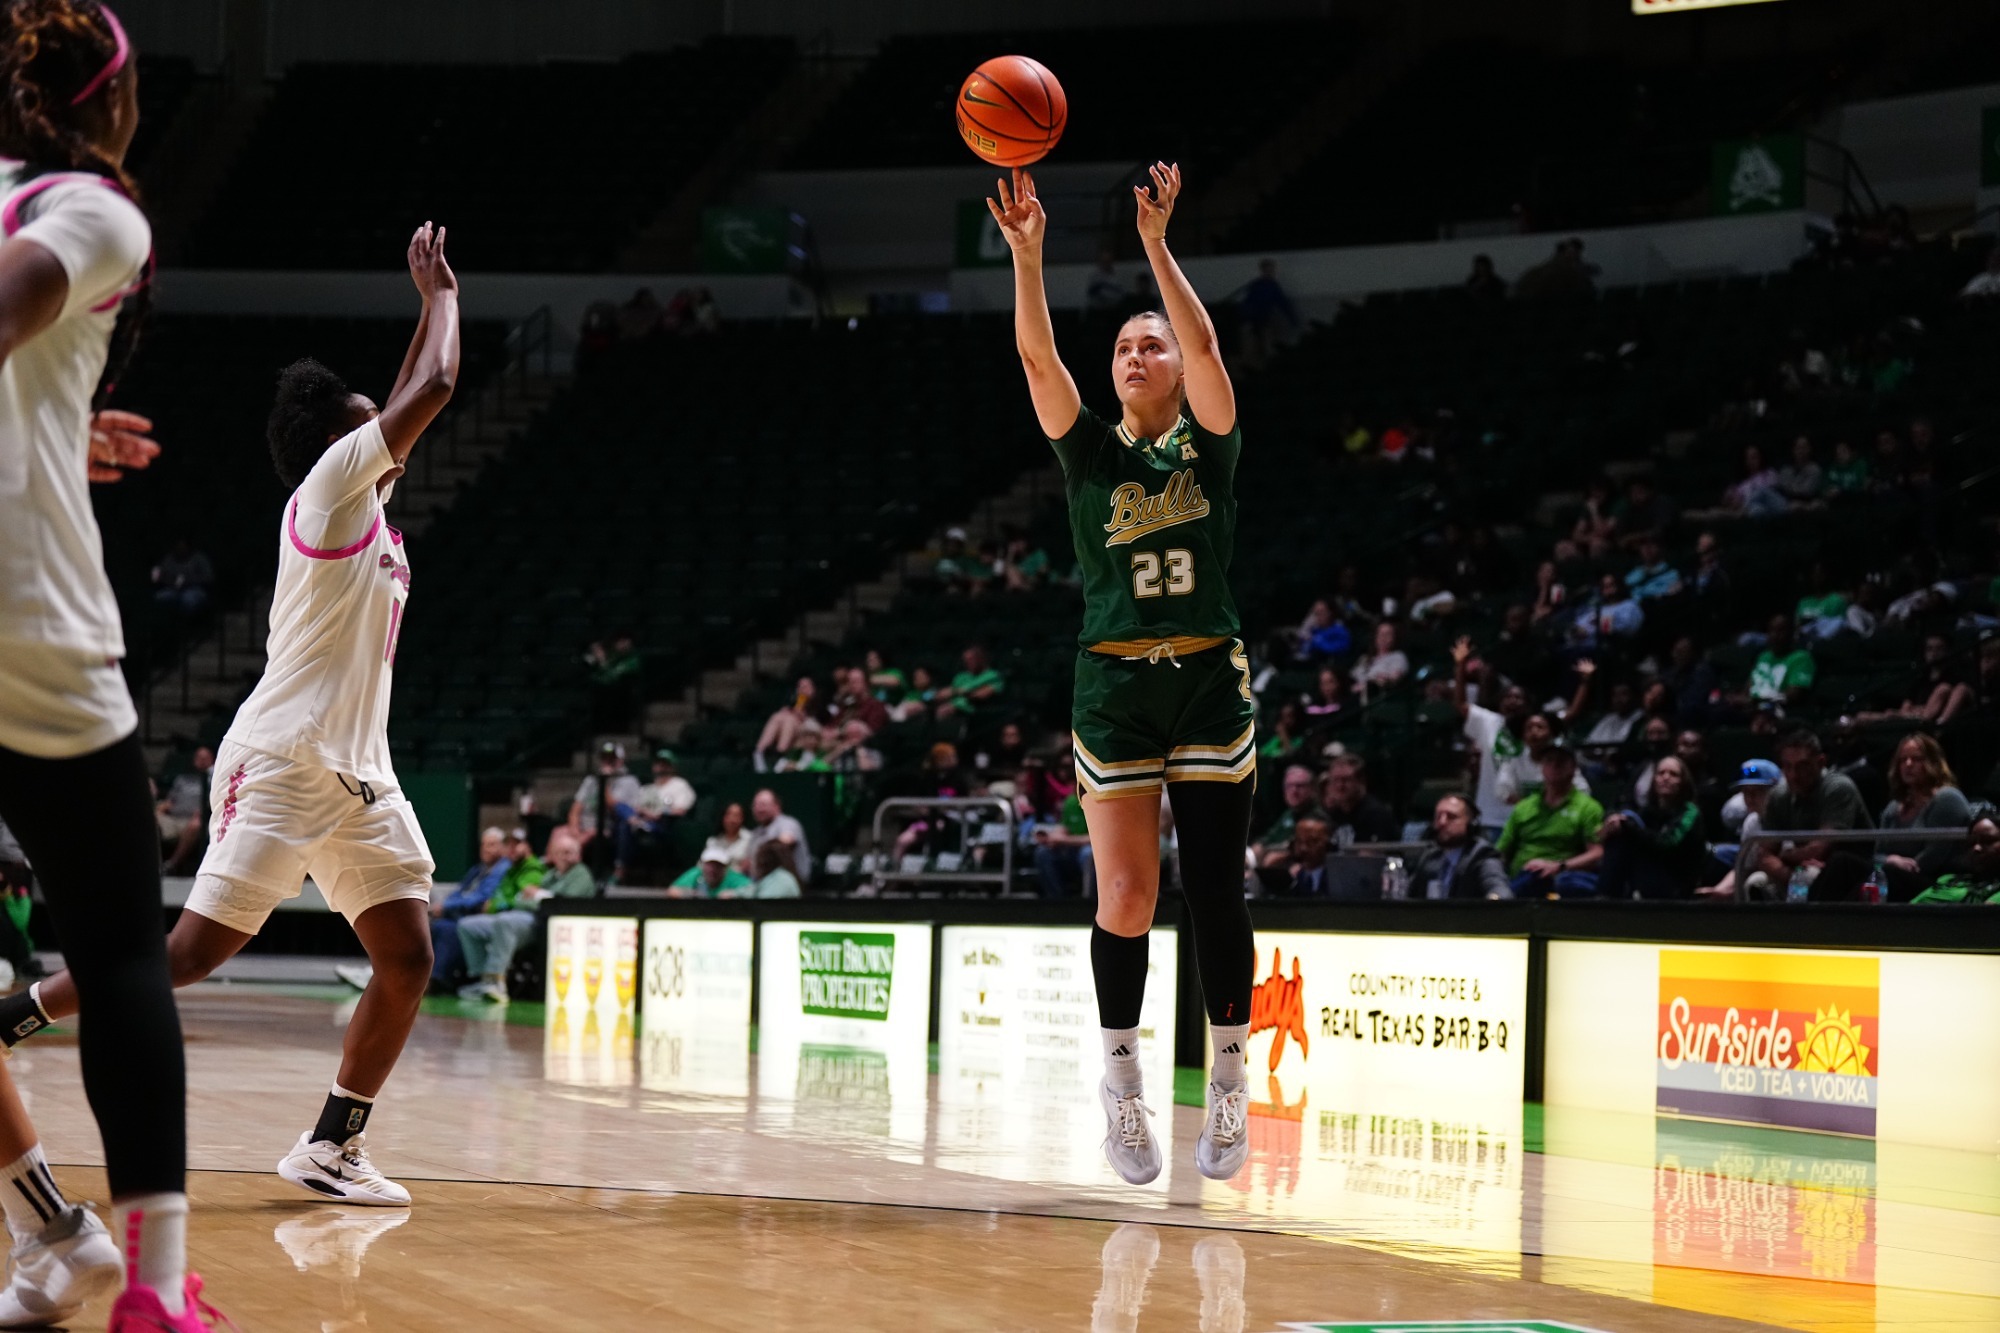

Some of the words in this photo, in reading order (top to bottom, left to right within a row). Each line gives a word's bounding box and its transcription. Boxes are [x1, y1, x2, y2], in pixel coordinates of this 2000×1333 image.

[1104, 468, 1210, 544] Bulls
[1131, 549, 1196, 599] 23
[800, 937, 842, 971] SCOTT
[842, 938, 893, 974] BROWN
[802, 973, 889, 1012] PROPERTIES
[1350, 973, 1414, 997] COUNTRY
[1421, 976, 1466, 1000] STORE
[1472, 978, 1482, 1001] &
[1321, 1006, 1363, 1039] REAL
[1368, 1009, 1425, 1046] TEXAS
[1660, 996, 1792, 1074] Surfside
[1720, 1067, 1757, 1094] ICED
[1760, 1069, 1793, 1097] TEA
[1810, 1073, 1870, 1105] VODKA
